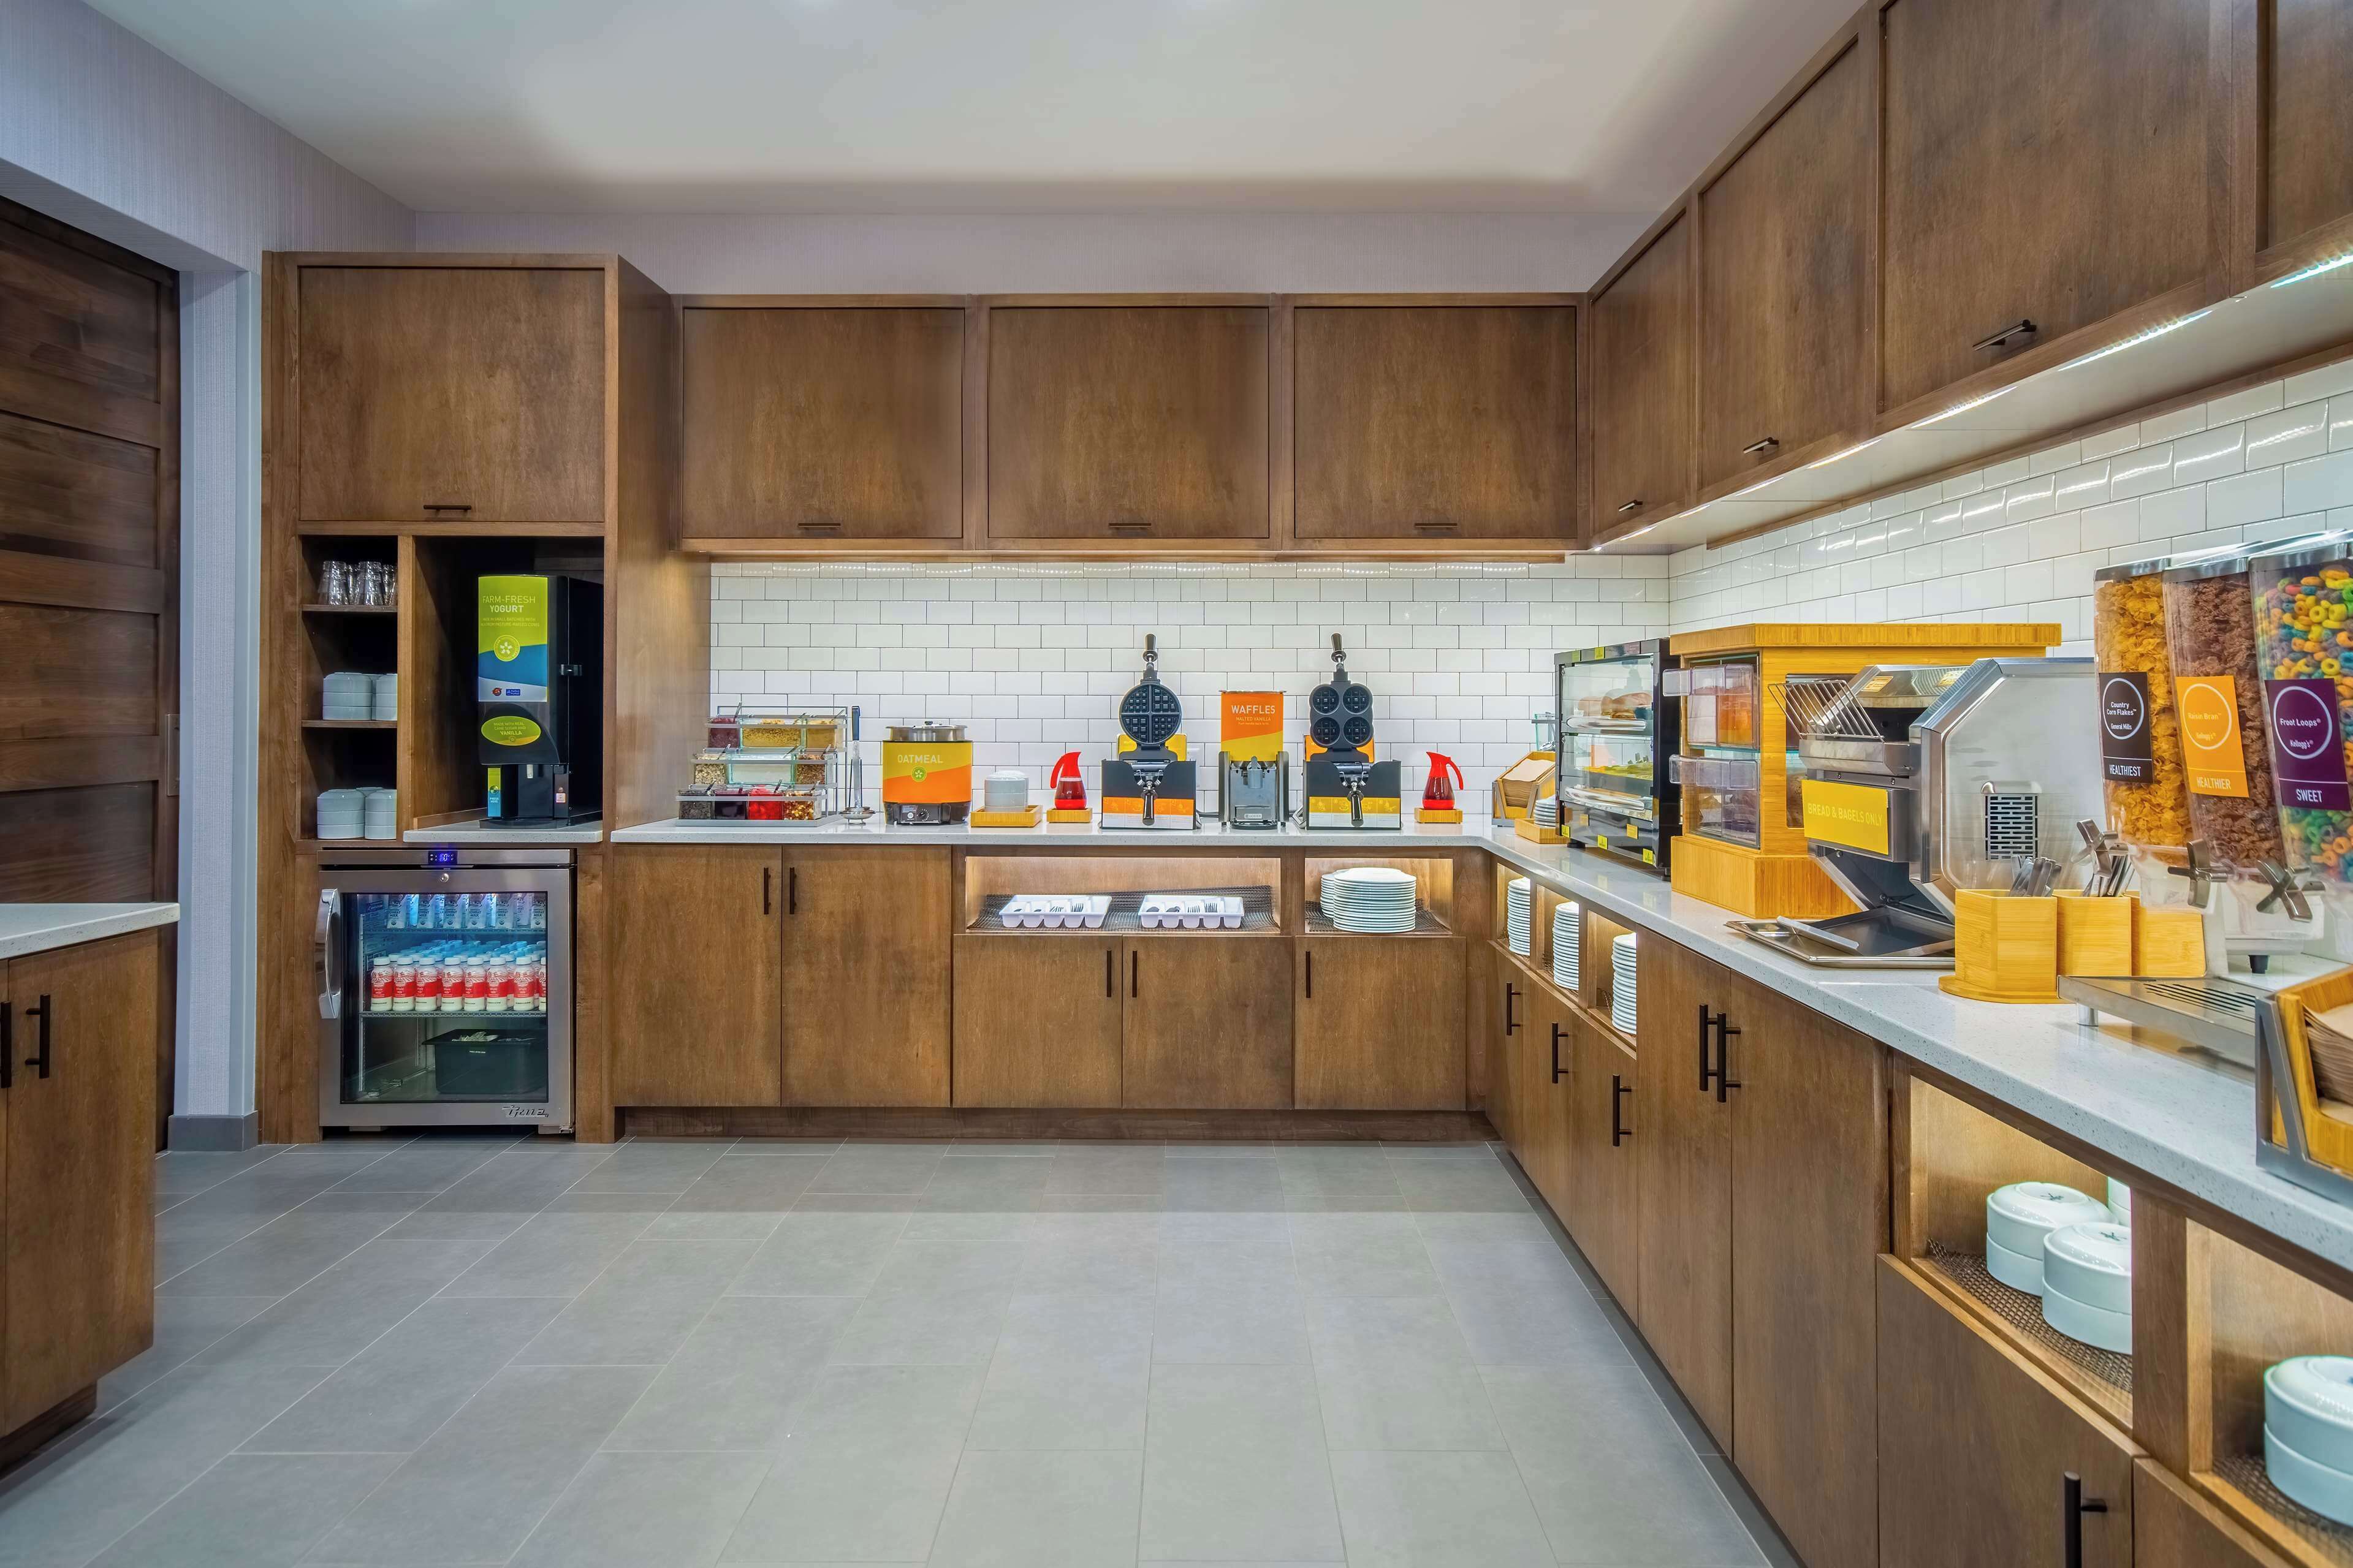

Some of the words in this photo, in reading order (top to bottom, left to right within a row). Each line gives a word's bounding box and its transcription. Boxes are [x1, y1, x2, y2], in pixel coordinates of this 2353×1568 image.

[482, 595, 536, 604] FARM-FRESH
[490, 605, 525, 613] YOGURT
[1231, 705, 1275, 714] WAFFLES
[897, 754, 943, 763] OATMEAL
[2109, 764, 2142, 777] HEALTHIEST
[2196, 776, 2232, 790] HEALTHIER
[2295, 788, 2322, 803] SWEET
[1808, 803, 1830, 817] BREAD
[1831, 806, 1838, 819] &
[1838, 807, 1865, 823] BAGELS
[1865, 812, 1883, 827] ONLY
